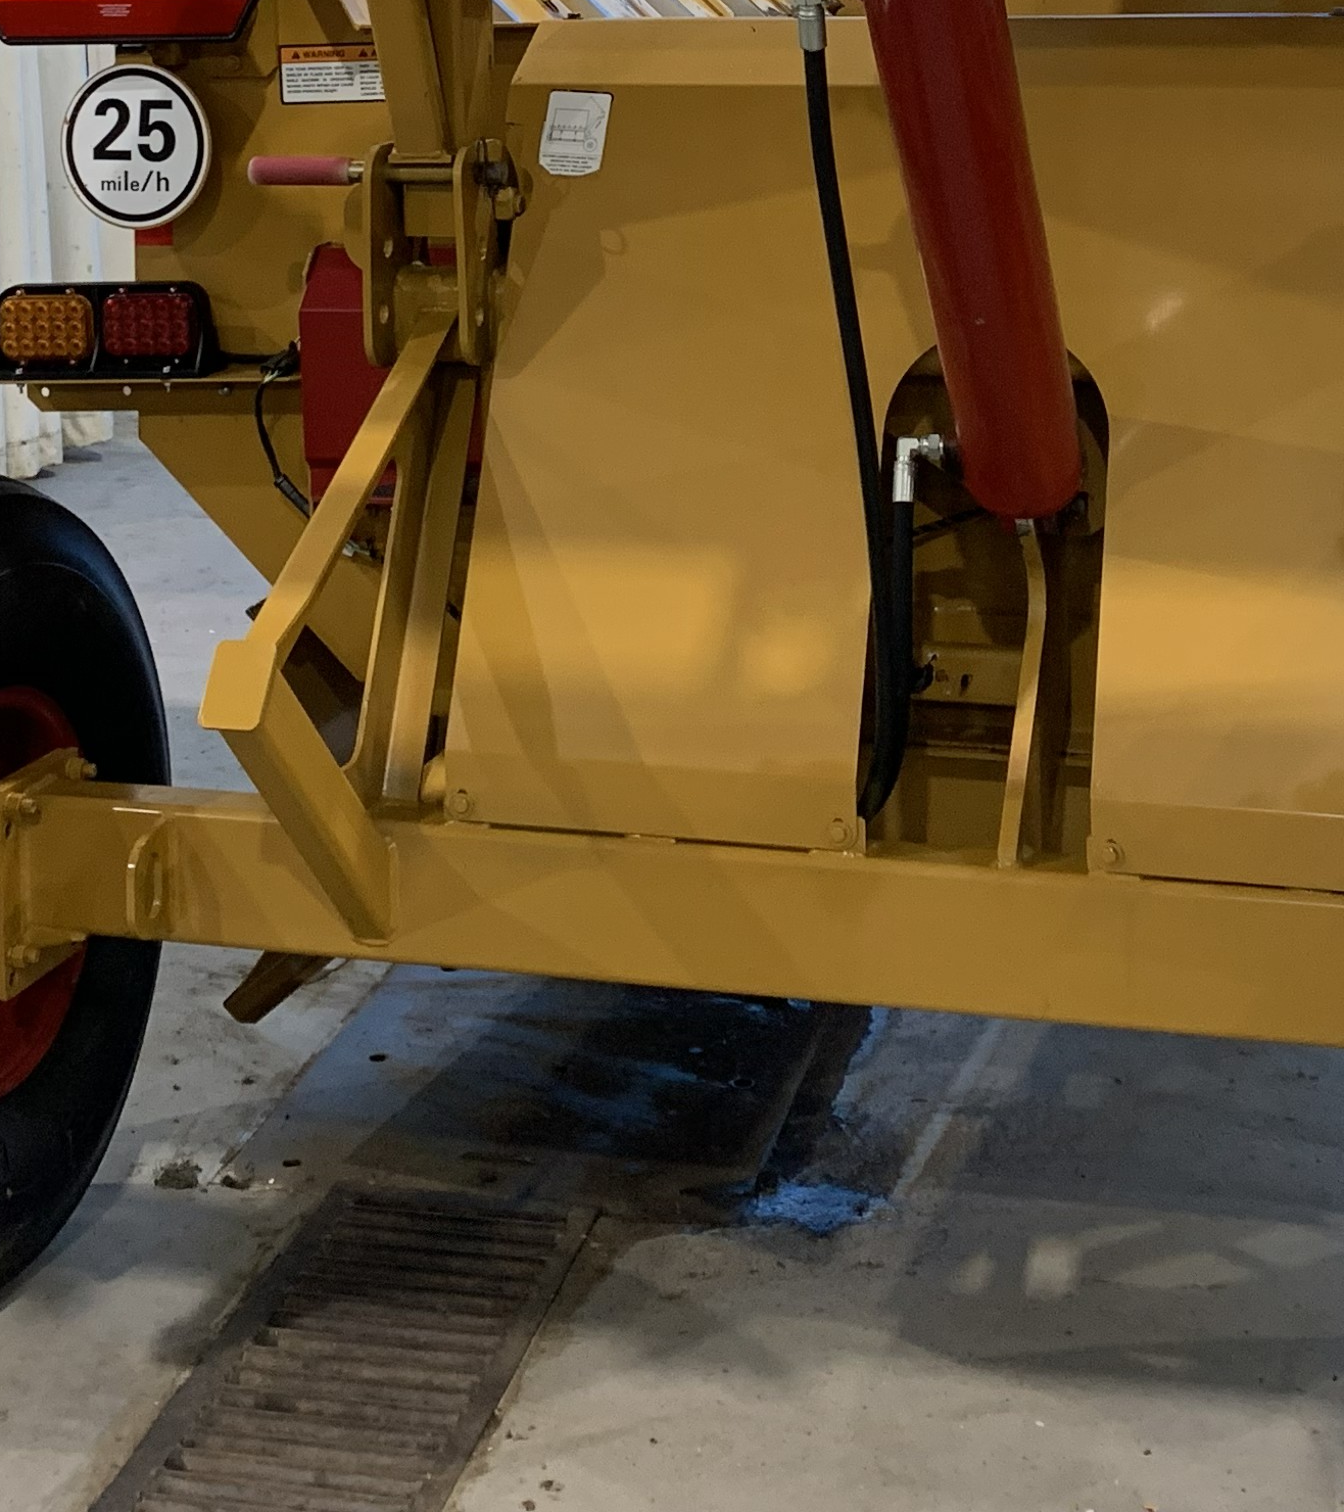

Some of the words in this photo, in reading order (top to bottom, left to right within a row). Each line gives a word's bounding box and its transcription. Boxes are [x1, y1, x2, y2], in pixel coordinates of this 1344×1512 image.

[302, 50, 346, 59] WARNING
[93, 98, 176, 163] 25
[101, 170, 170, 192] mile/h
